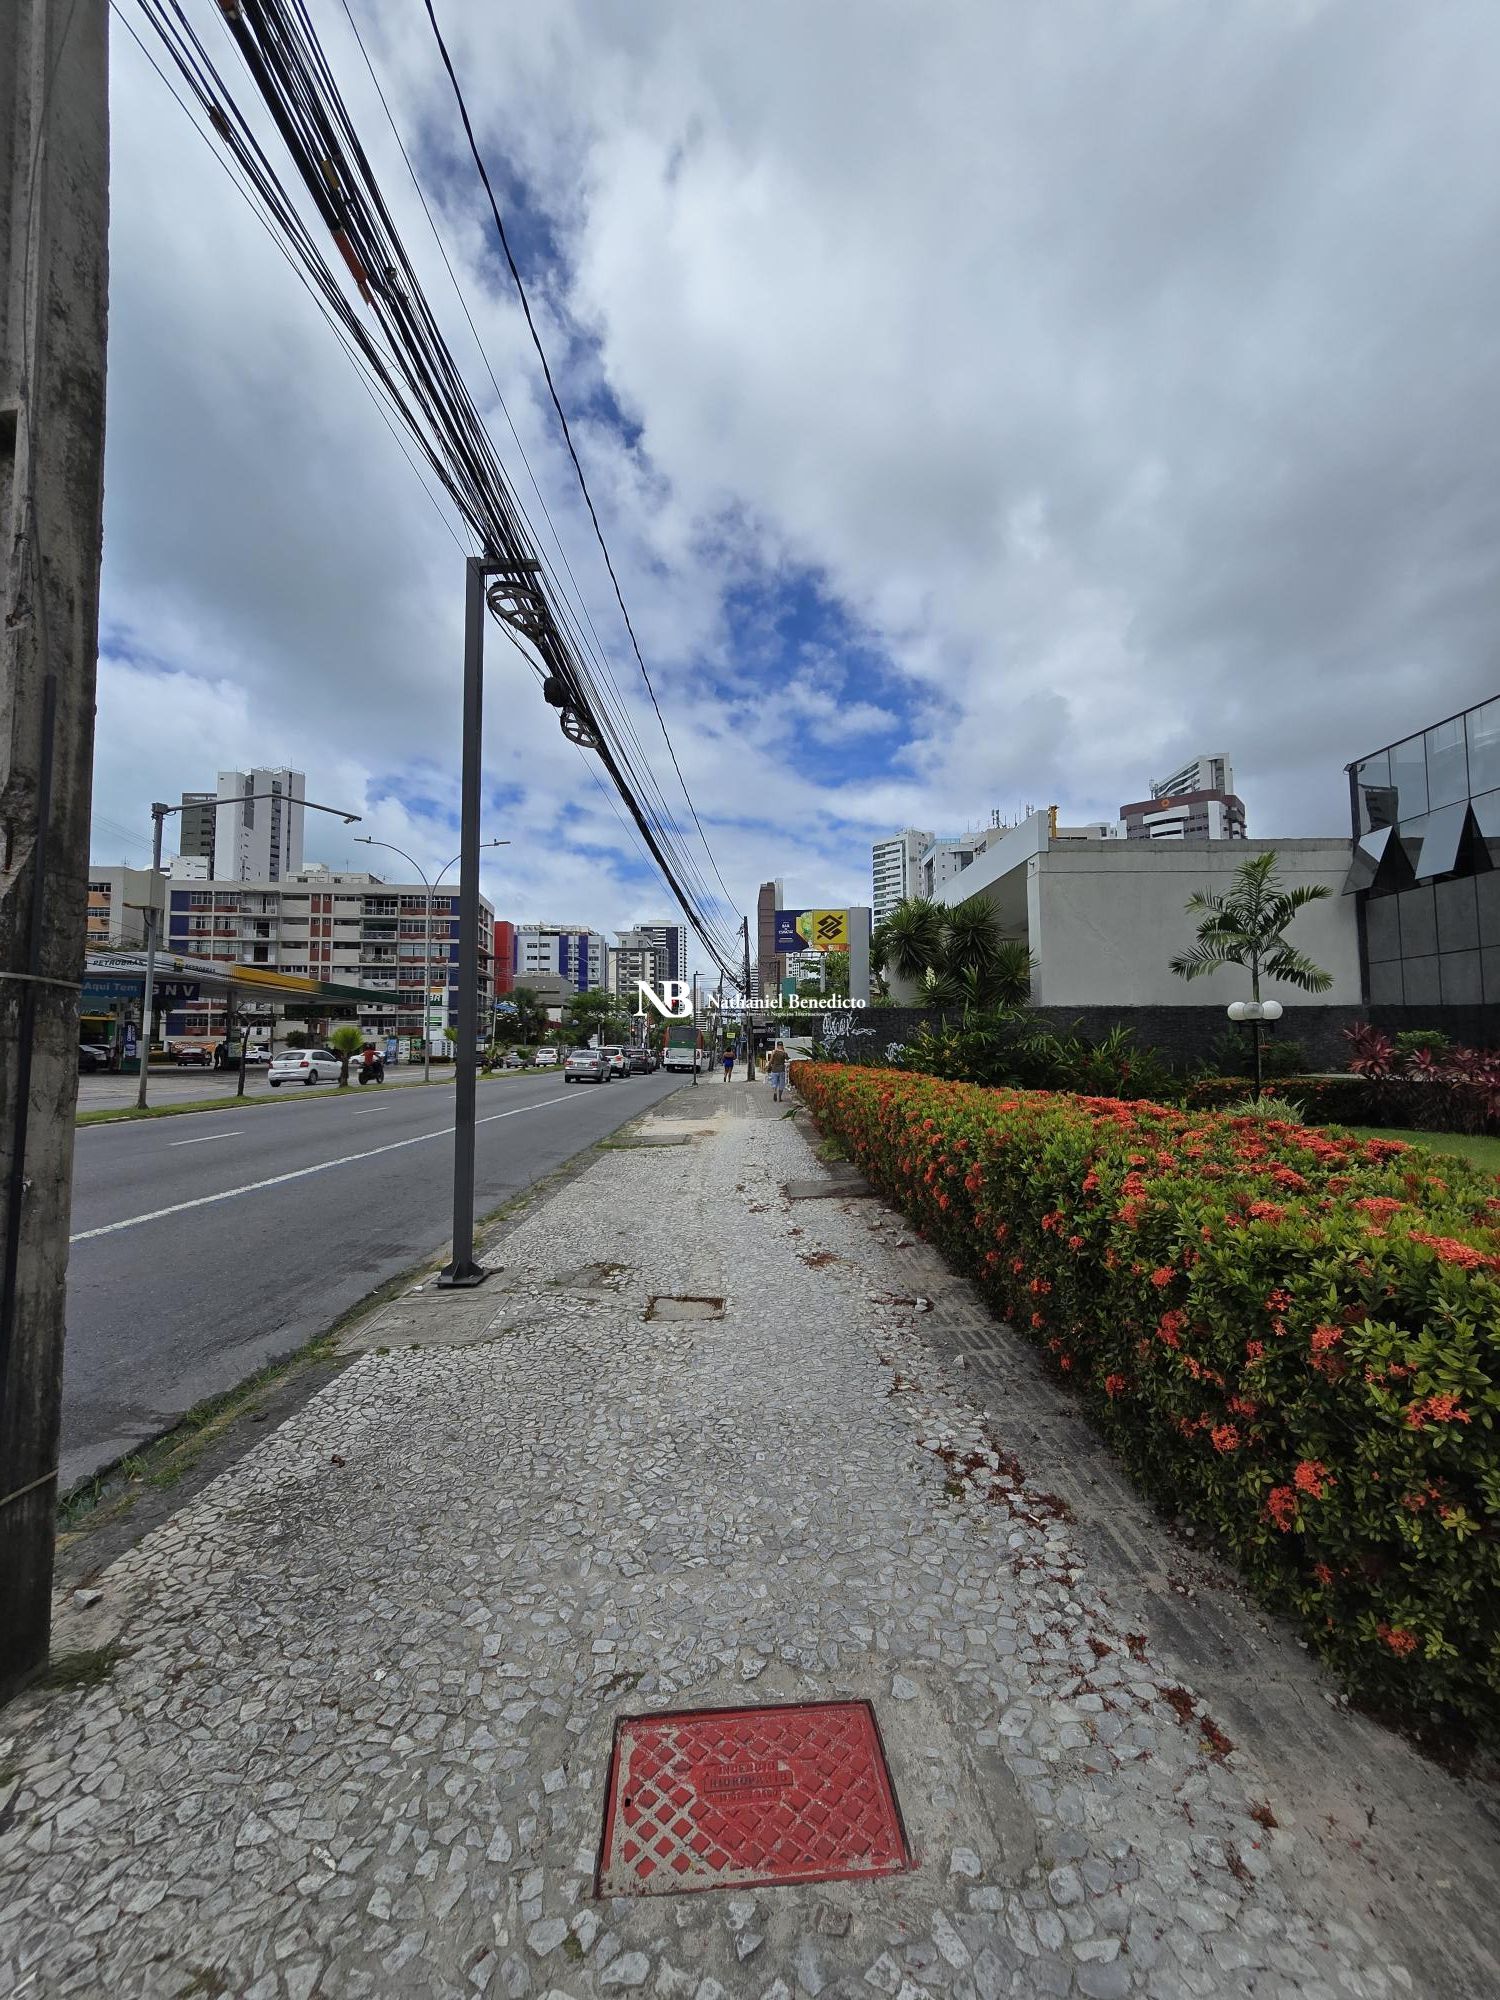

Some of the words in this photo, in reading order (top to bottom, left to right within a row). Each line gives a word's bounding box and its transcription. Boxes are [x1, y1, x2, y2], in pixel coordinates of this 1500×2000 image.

[83, 981, 111, 992] Aqui
[112, 982, 138, 992] Tem
[151, 984, 195, 997] GNV
